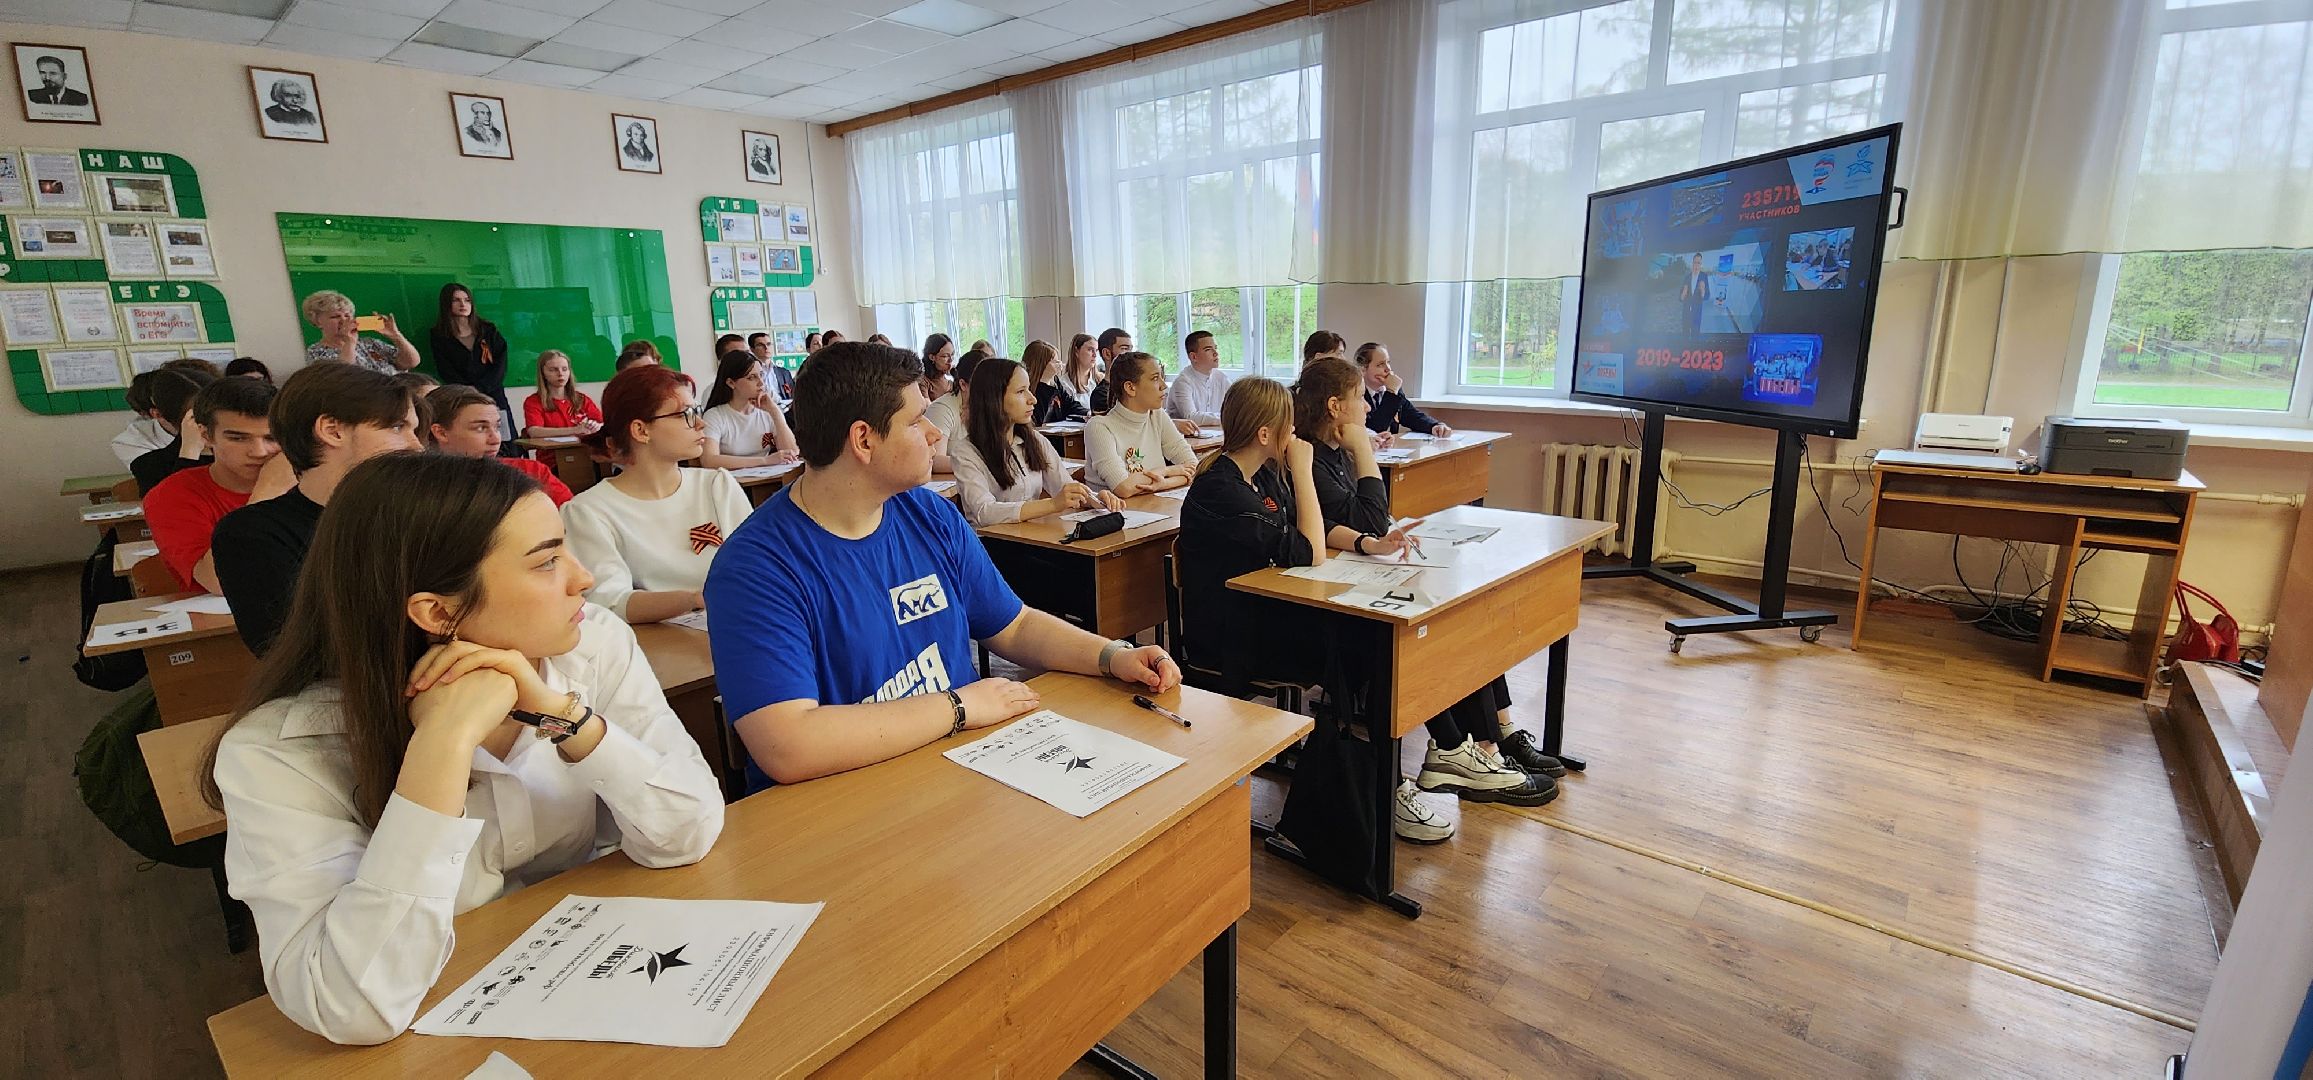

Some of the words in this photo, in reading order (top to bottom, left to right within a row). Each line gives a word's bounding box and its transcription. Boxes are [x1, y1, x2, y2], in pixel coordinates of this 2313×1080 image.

[87, 153, 164, 170] НАШ
[1737, 204, 1800, 222] УЧАСТНИКОВ
[119, 285, 191, 299] ЕГЭ
[715, 289, 763, 299] МИРЕ
[133, 309, 166, 318] Время
[171, 651, 193, 664] 209
[584, 944, 634, 978] ПОБЕДЫ
